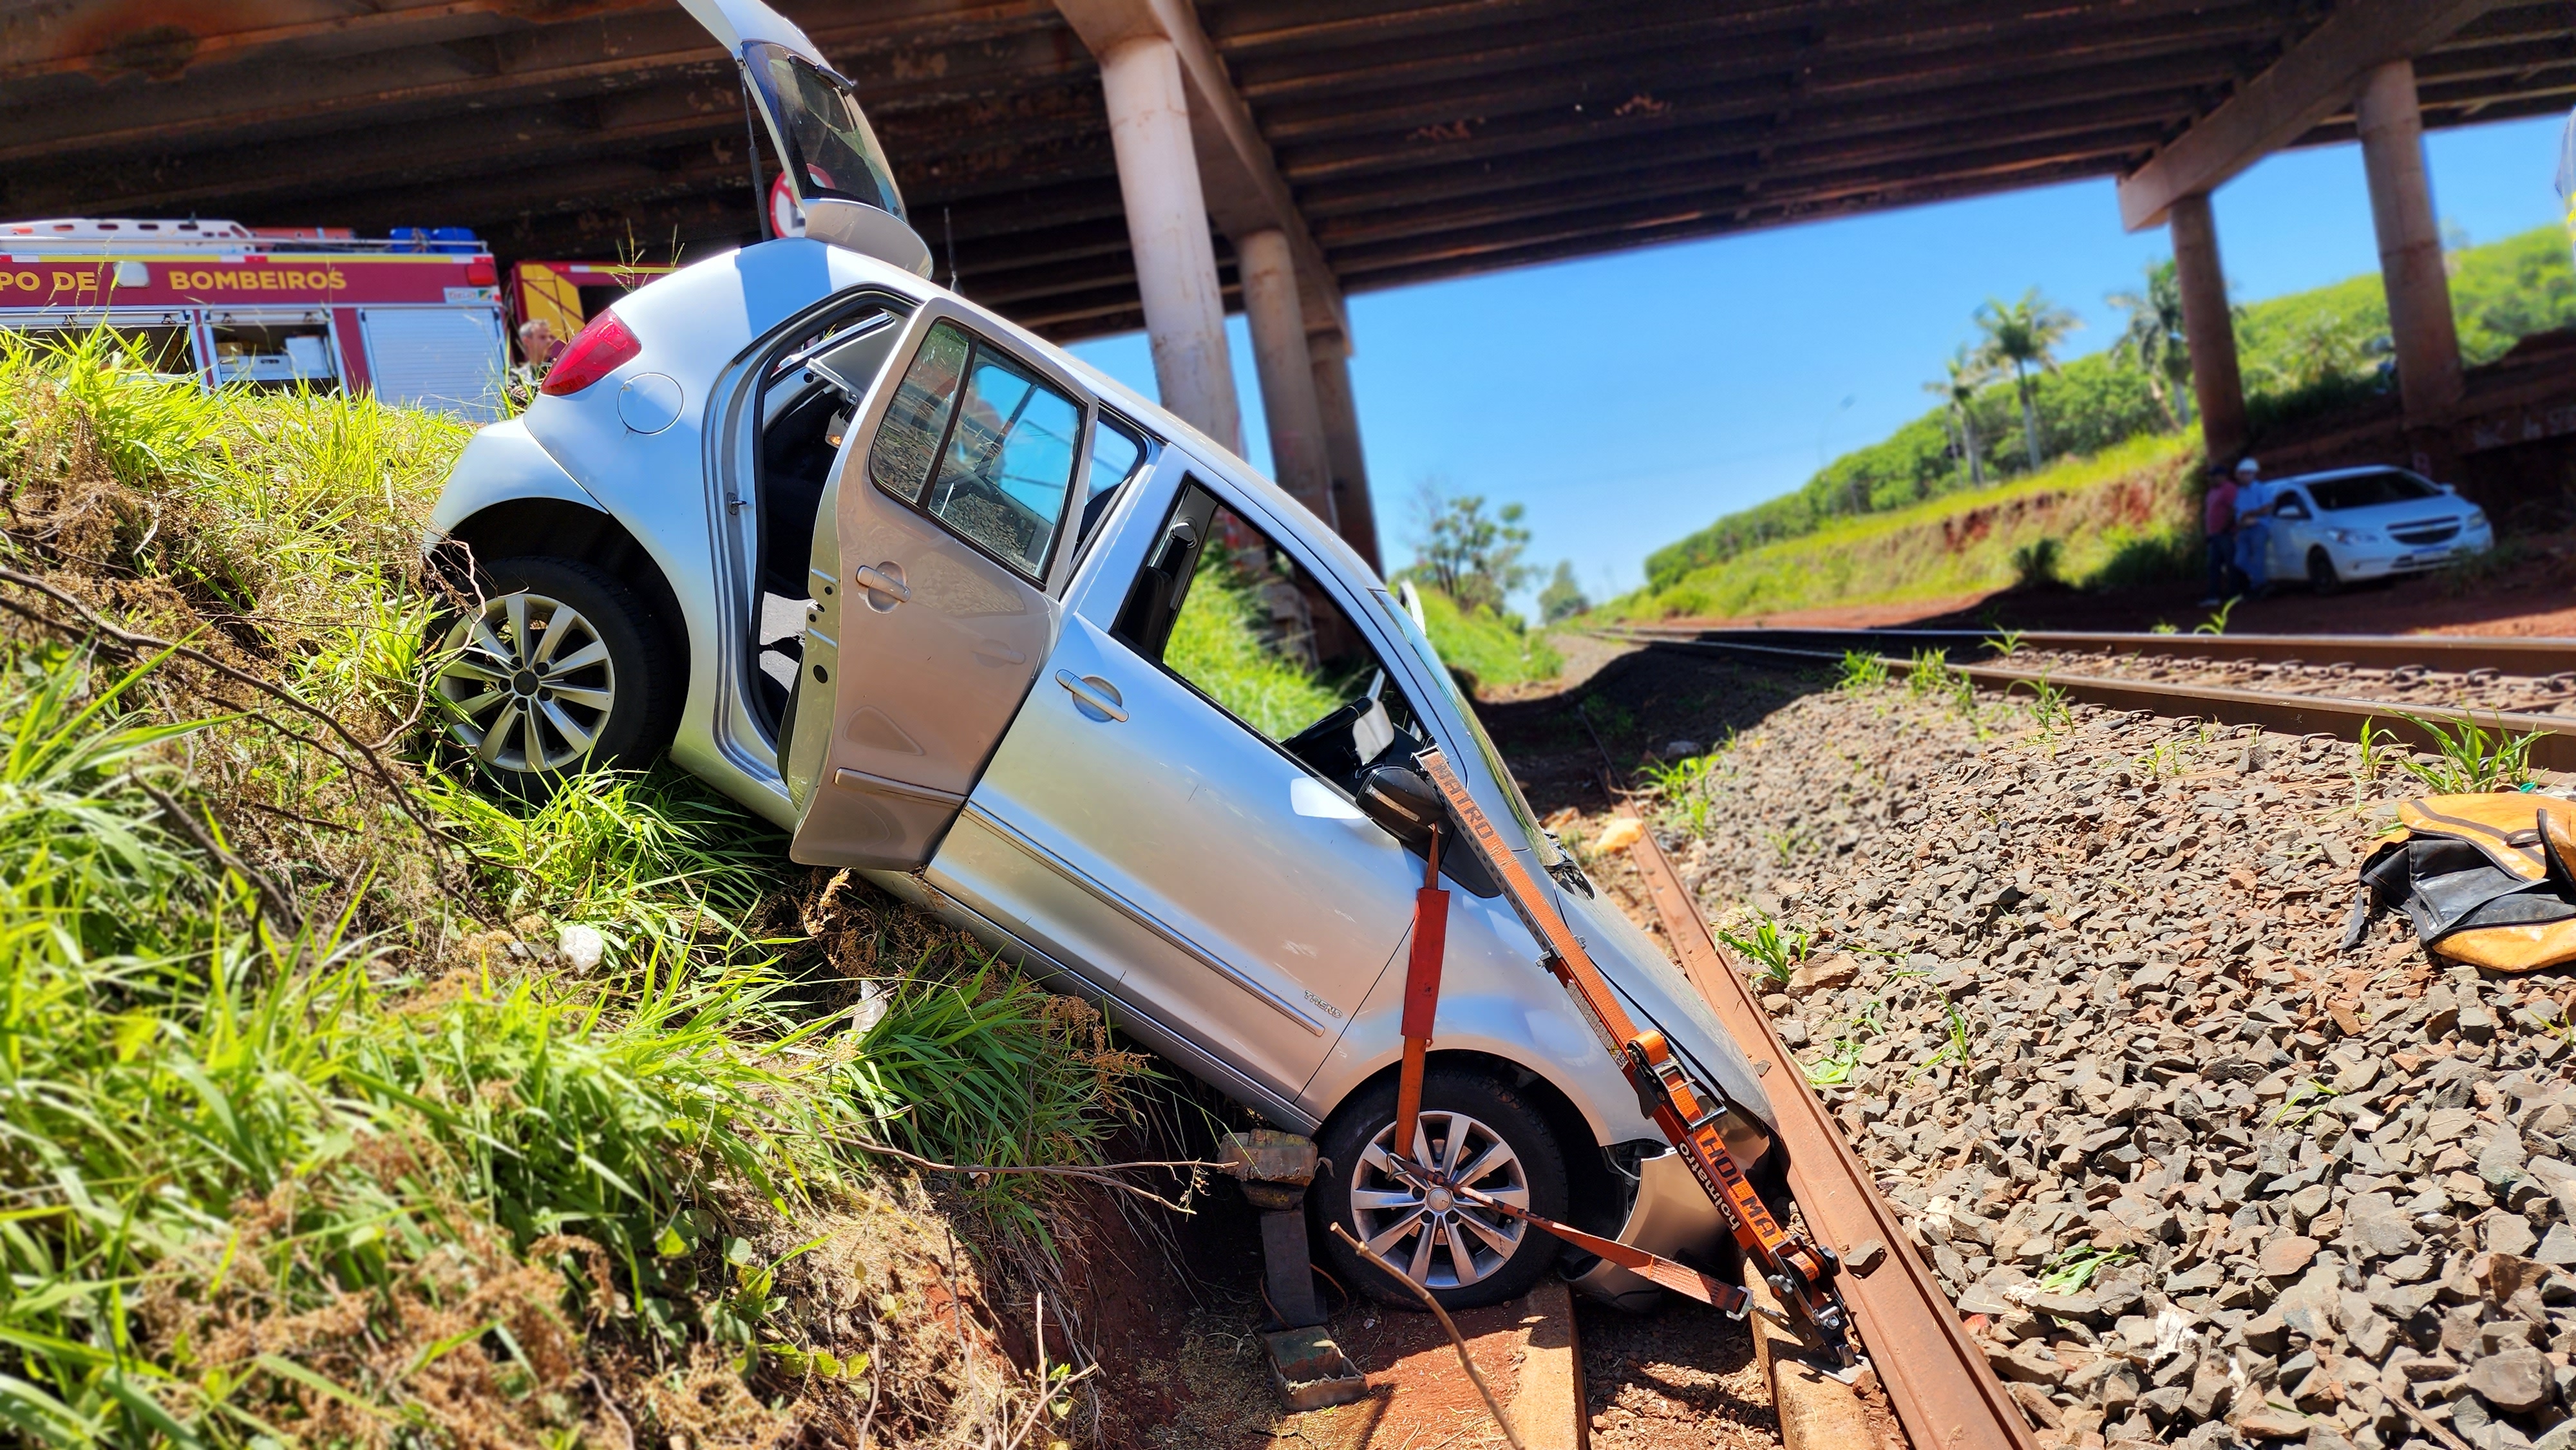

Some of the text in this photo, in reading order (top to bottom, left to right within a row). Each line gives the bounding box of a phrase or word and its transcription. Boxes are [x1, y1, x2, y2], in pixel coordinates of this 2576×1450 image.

[52, 272, 97, 290] DE
[169, 271, 346, 290] BOMBEIROS
[1304, 990, 1343, 1019] TREND
[1679, 1142, 1740, 1231] holmatro
